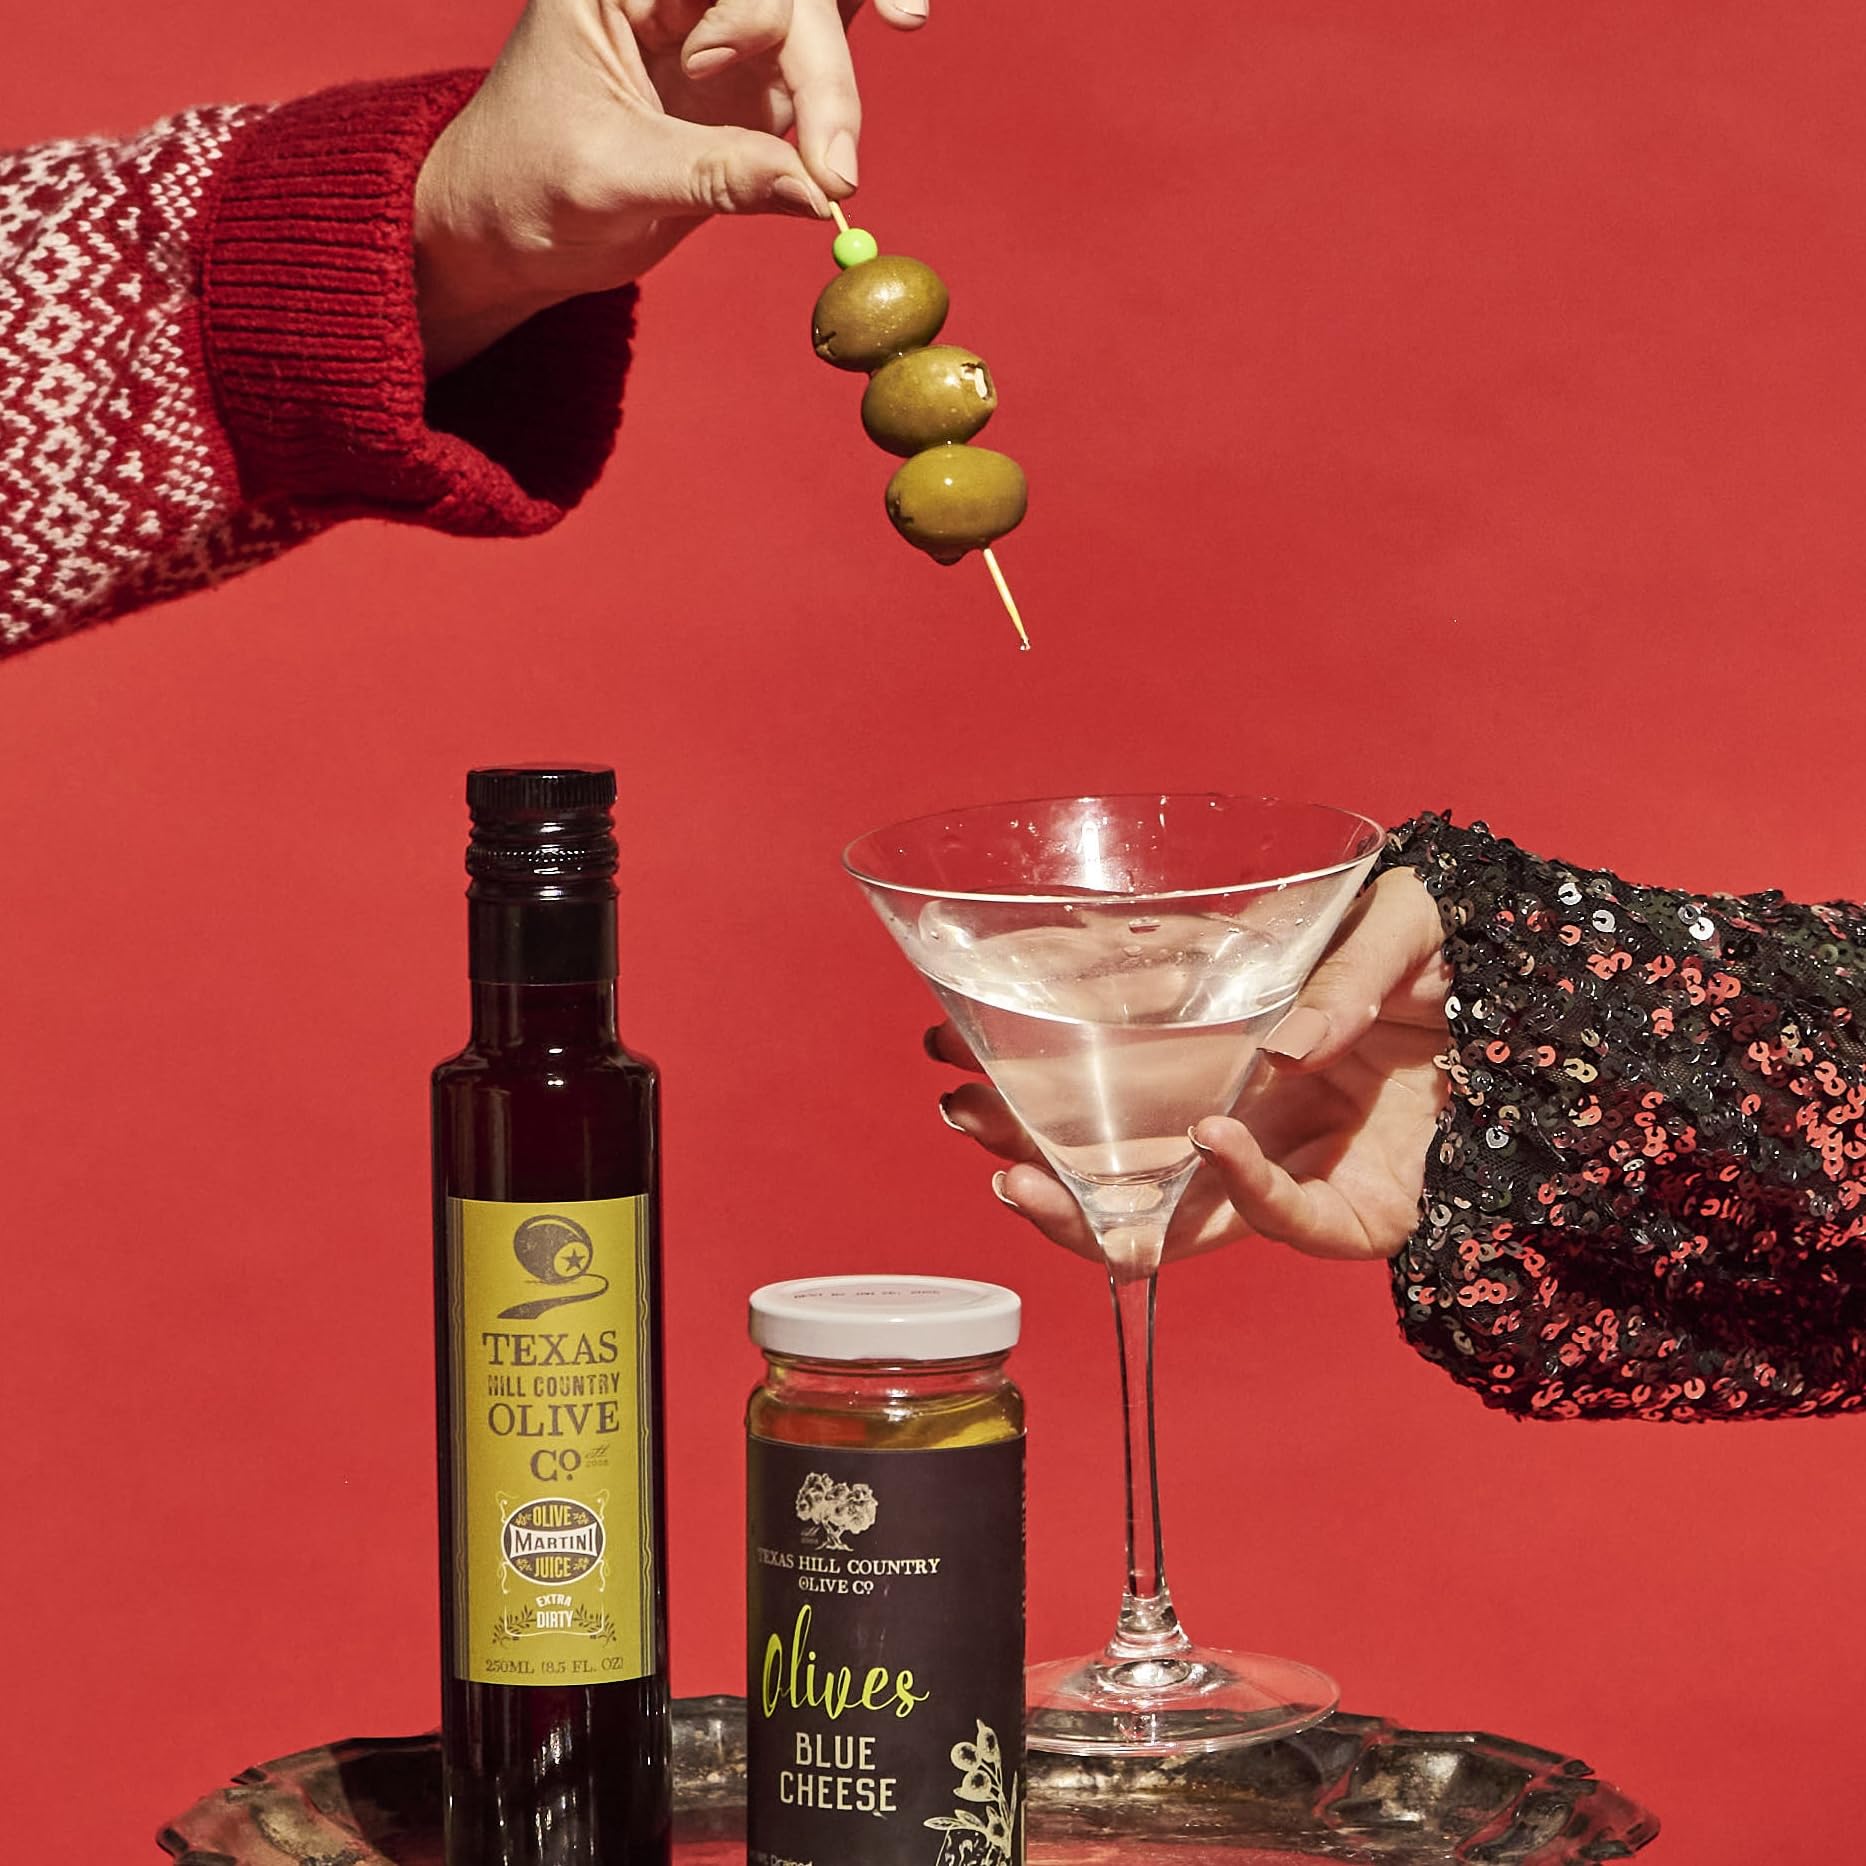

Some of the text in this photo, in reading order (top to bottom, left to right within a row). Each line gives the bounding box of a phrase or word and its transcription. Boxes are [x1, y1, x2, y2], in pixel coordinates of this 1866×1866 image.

[482, 1330, 618, 1366] TEXAS
[488, 1372, 620, 1397] HILL COUNTRY
[488, 1400, 620, 1437] OLIVE
[532, 1504, 572, 1528] OLIVE
[515, 1528, 593, 1553] MARTINI
[534, 1556, 572, 1579] JUICE
[757, 1547, 941, 1575] TEXAS HILL COUNTRY
[798, 1575, 848, 1594] OLIVE
[535, 1593, 572, 1607] EXTRA
[536, 1610, 574, 1628] DIRTY
[485, 1658, 534, 1674] 250ML
[541, 1660, 566, 1673] (8.5
[572, 1660, 597, 1673] FL.
[763, 1604, 930, 1719] Olives
[795, 1732, 876, 1770] BLUE
[779, 1771, 897, 1812] CHEESE
